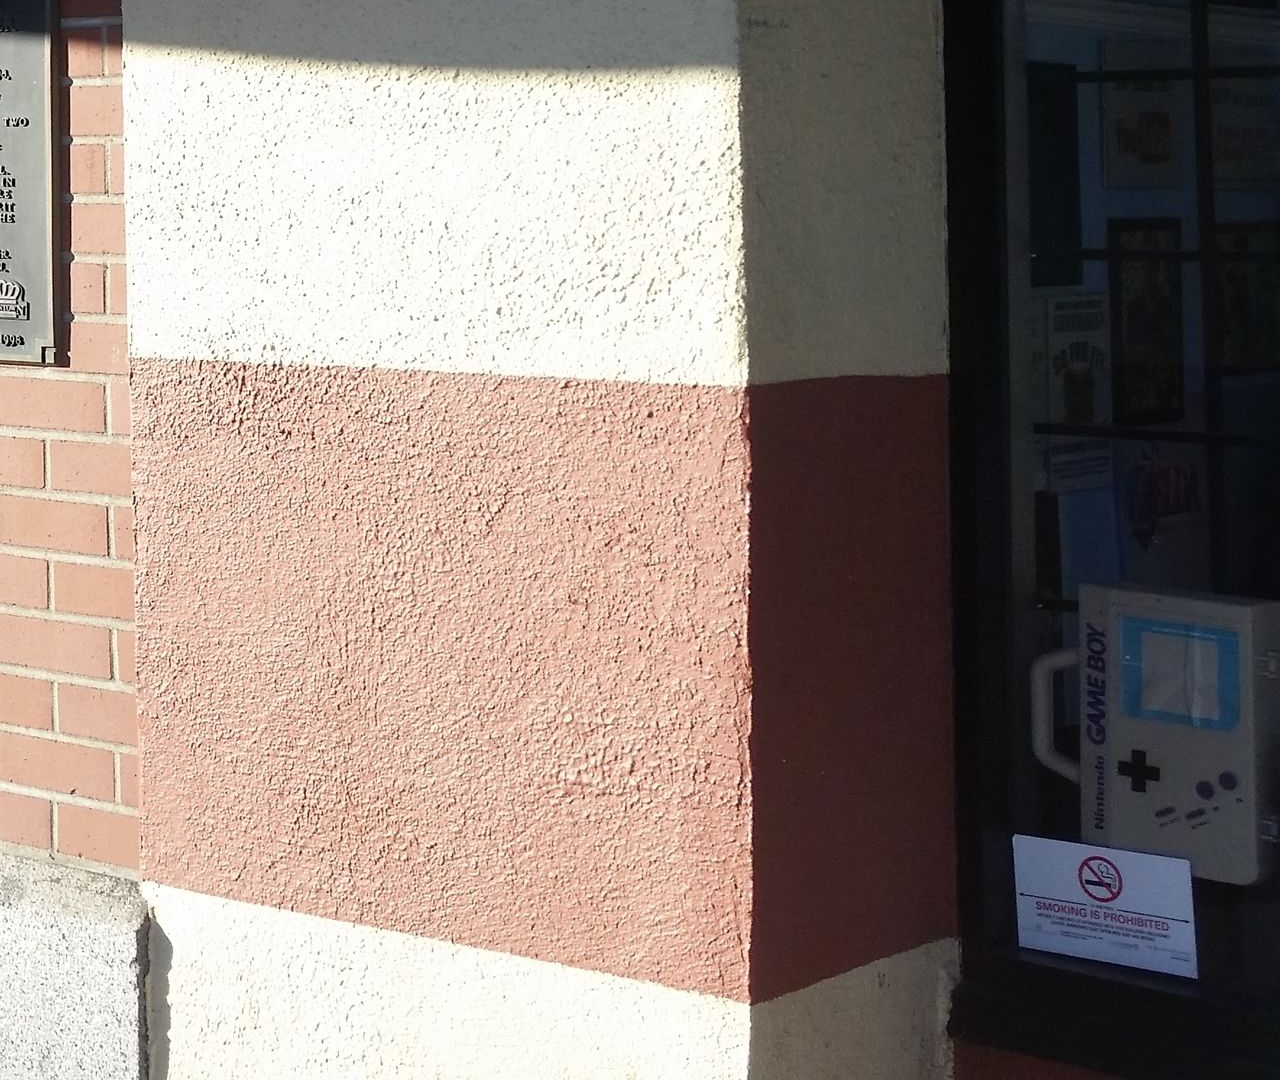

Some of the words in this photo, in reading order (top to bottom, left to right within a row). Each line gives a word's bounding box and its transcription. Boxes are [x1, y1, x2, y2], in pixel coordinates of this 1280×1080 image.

[3, 117, 29, 127] TWO
[3, 177, 16, 187] IN
[1, 335, 25, 346] 1998
[1086, 623, 1106, 672] BOY
[1086, 677, 1106, 746] GAME
[1094, 756, 1104, 830] Nintendo
[1035, 901, 1087, 918] SMOKING
[1090, 910, 1100, 920] IS
[1104, 913, 1169, 931] PROHIBITED
